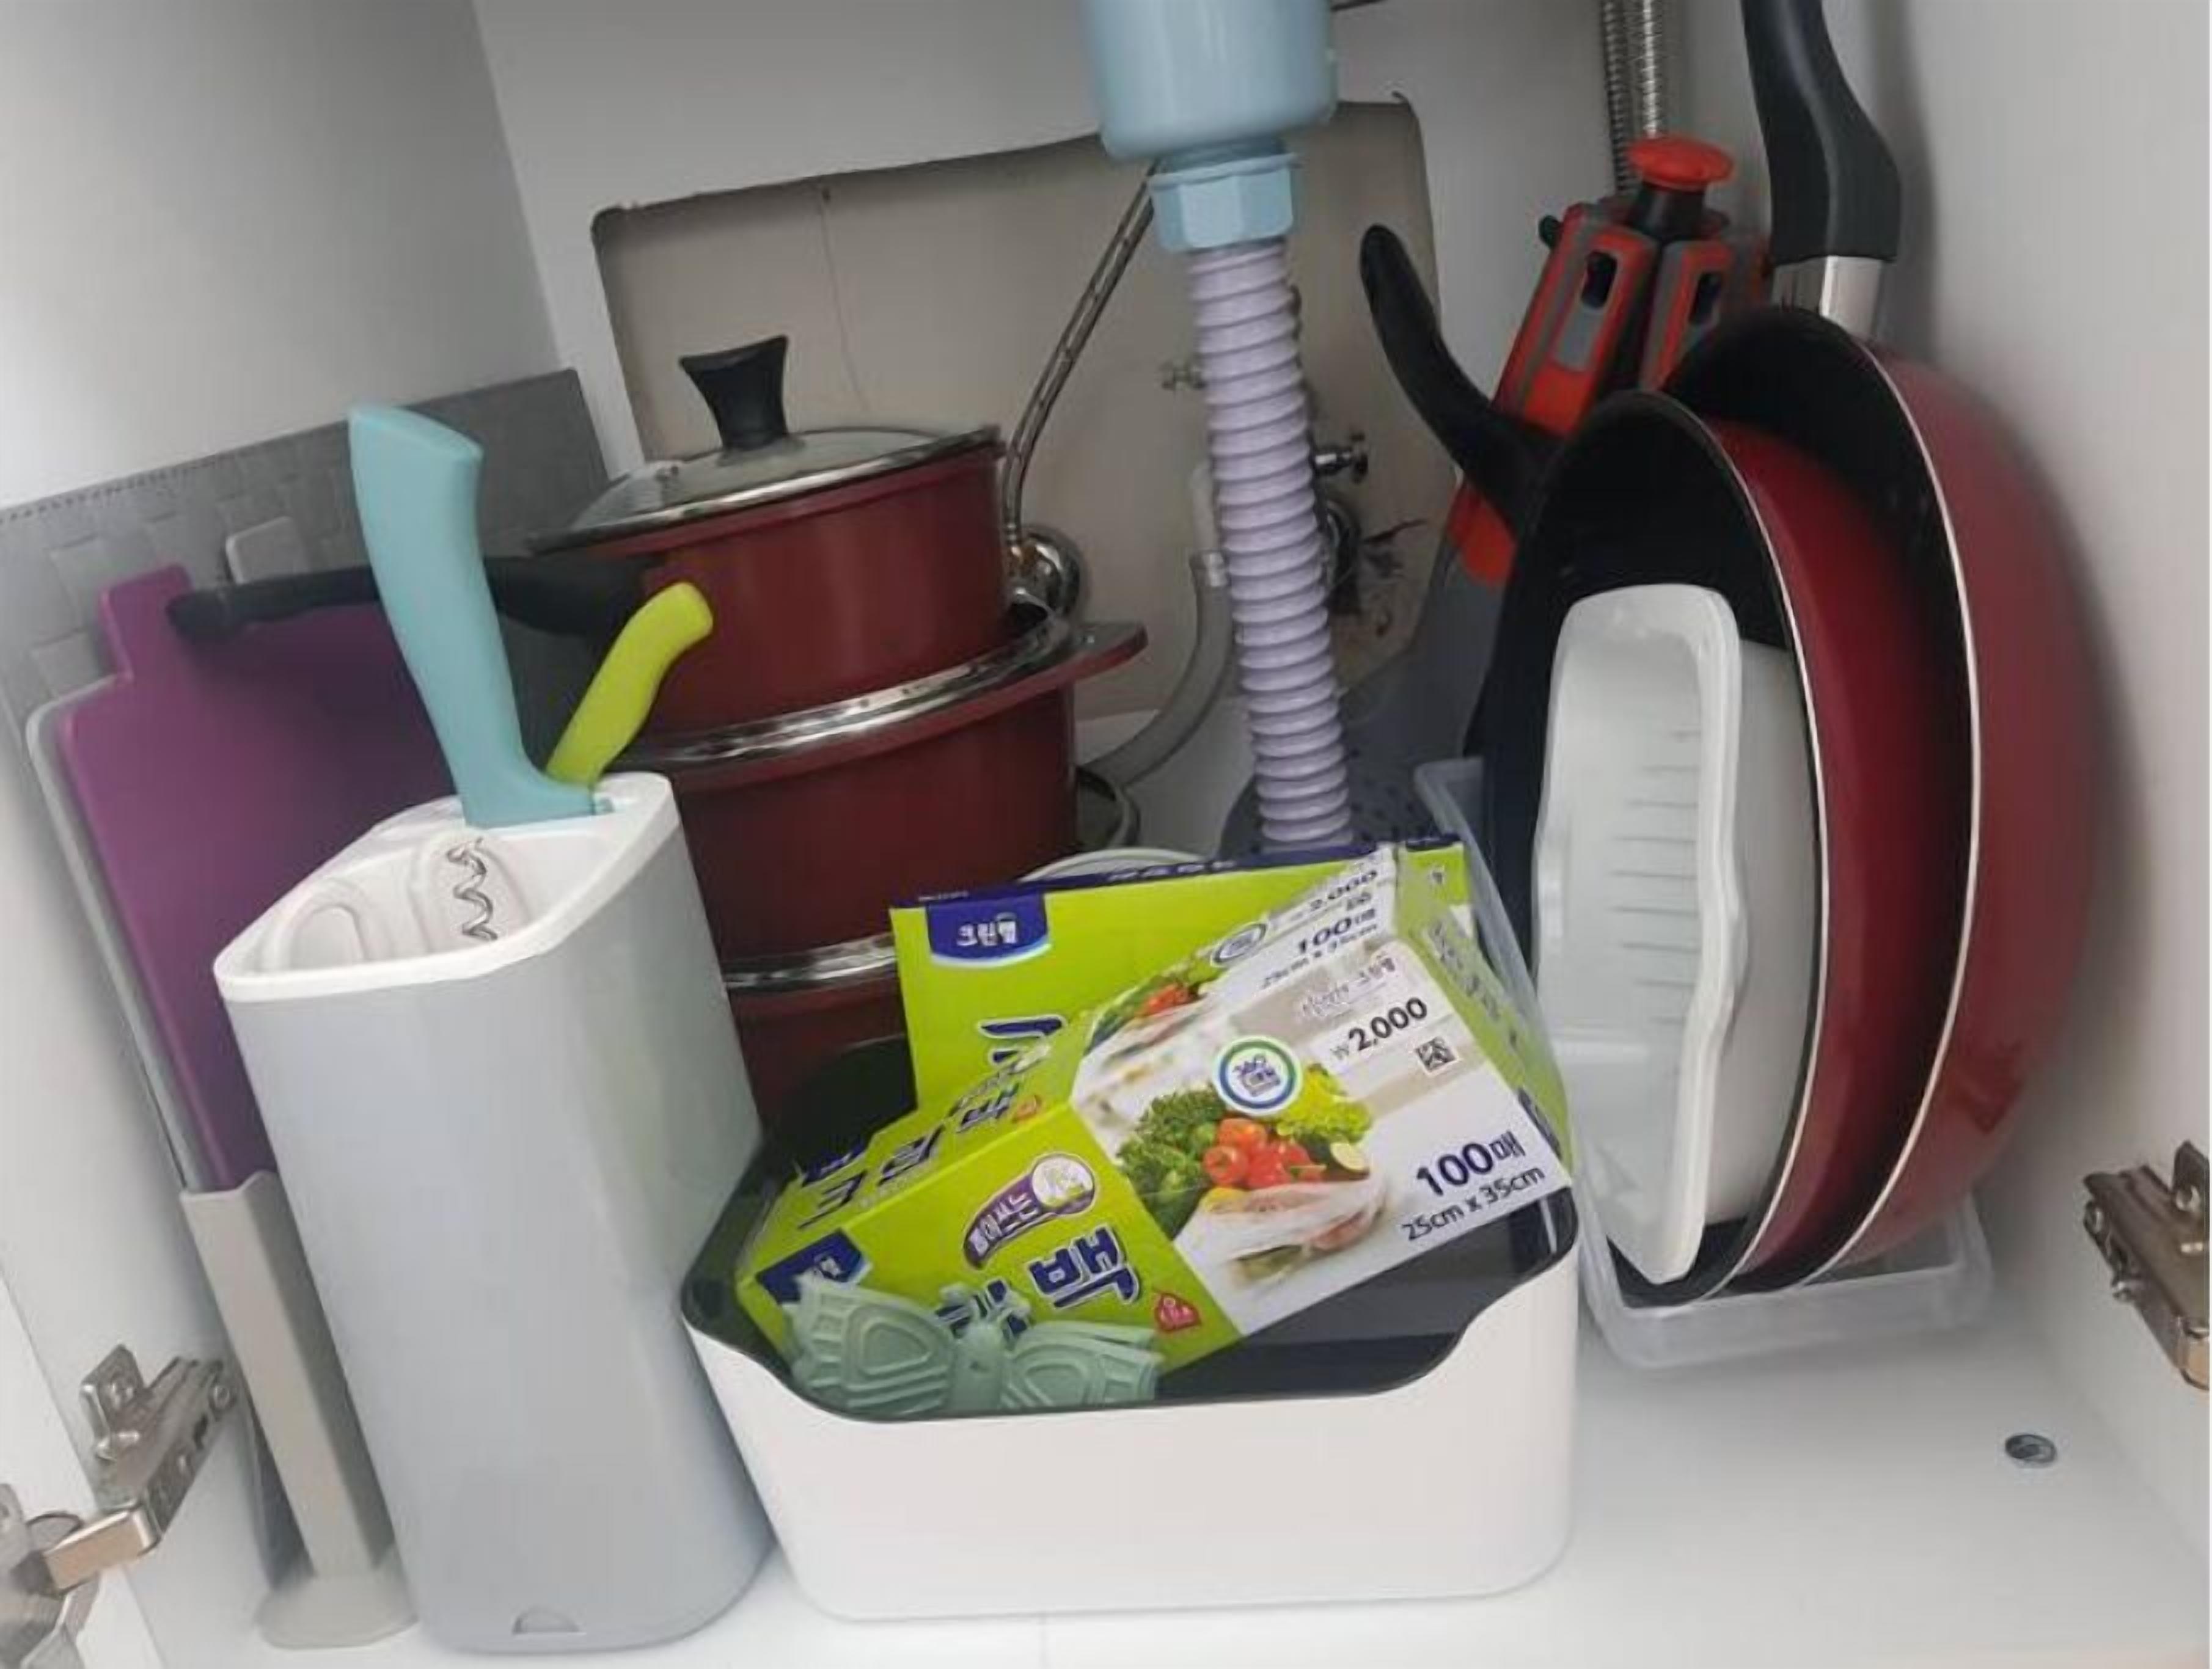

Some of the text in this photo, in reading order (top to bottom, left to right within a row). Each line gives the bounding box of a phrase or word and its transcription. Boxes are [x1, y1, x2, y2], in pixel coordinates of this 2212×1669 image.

[1416, 1130, 1526, 1196] 100매
[1401, 1204, 1465, 1241] 25cm
[1479, 1167, 1545, 1204] 35cm
